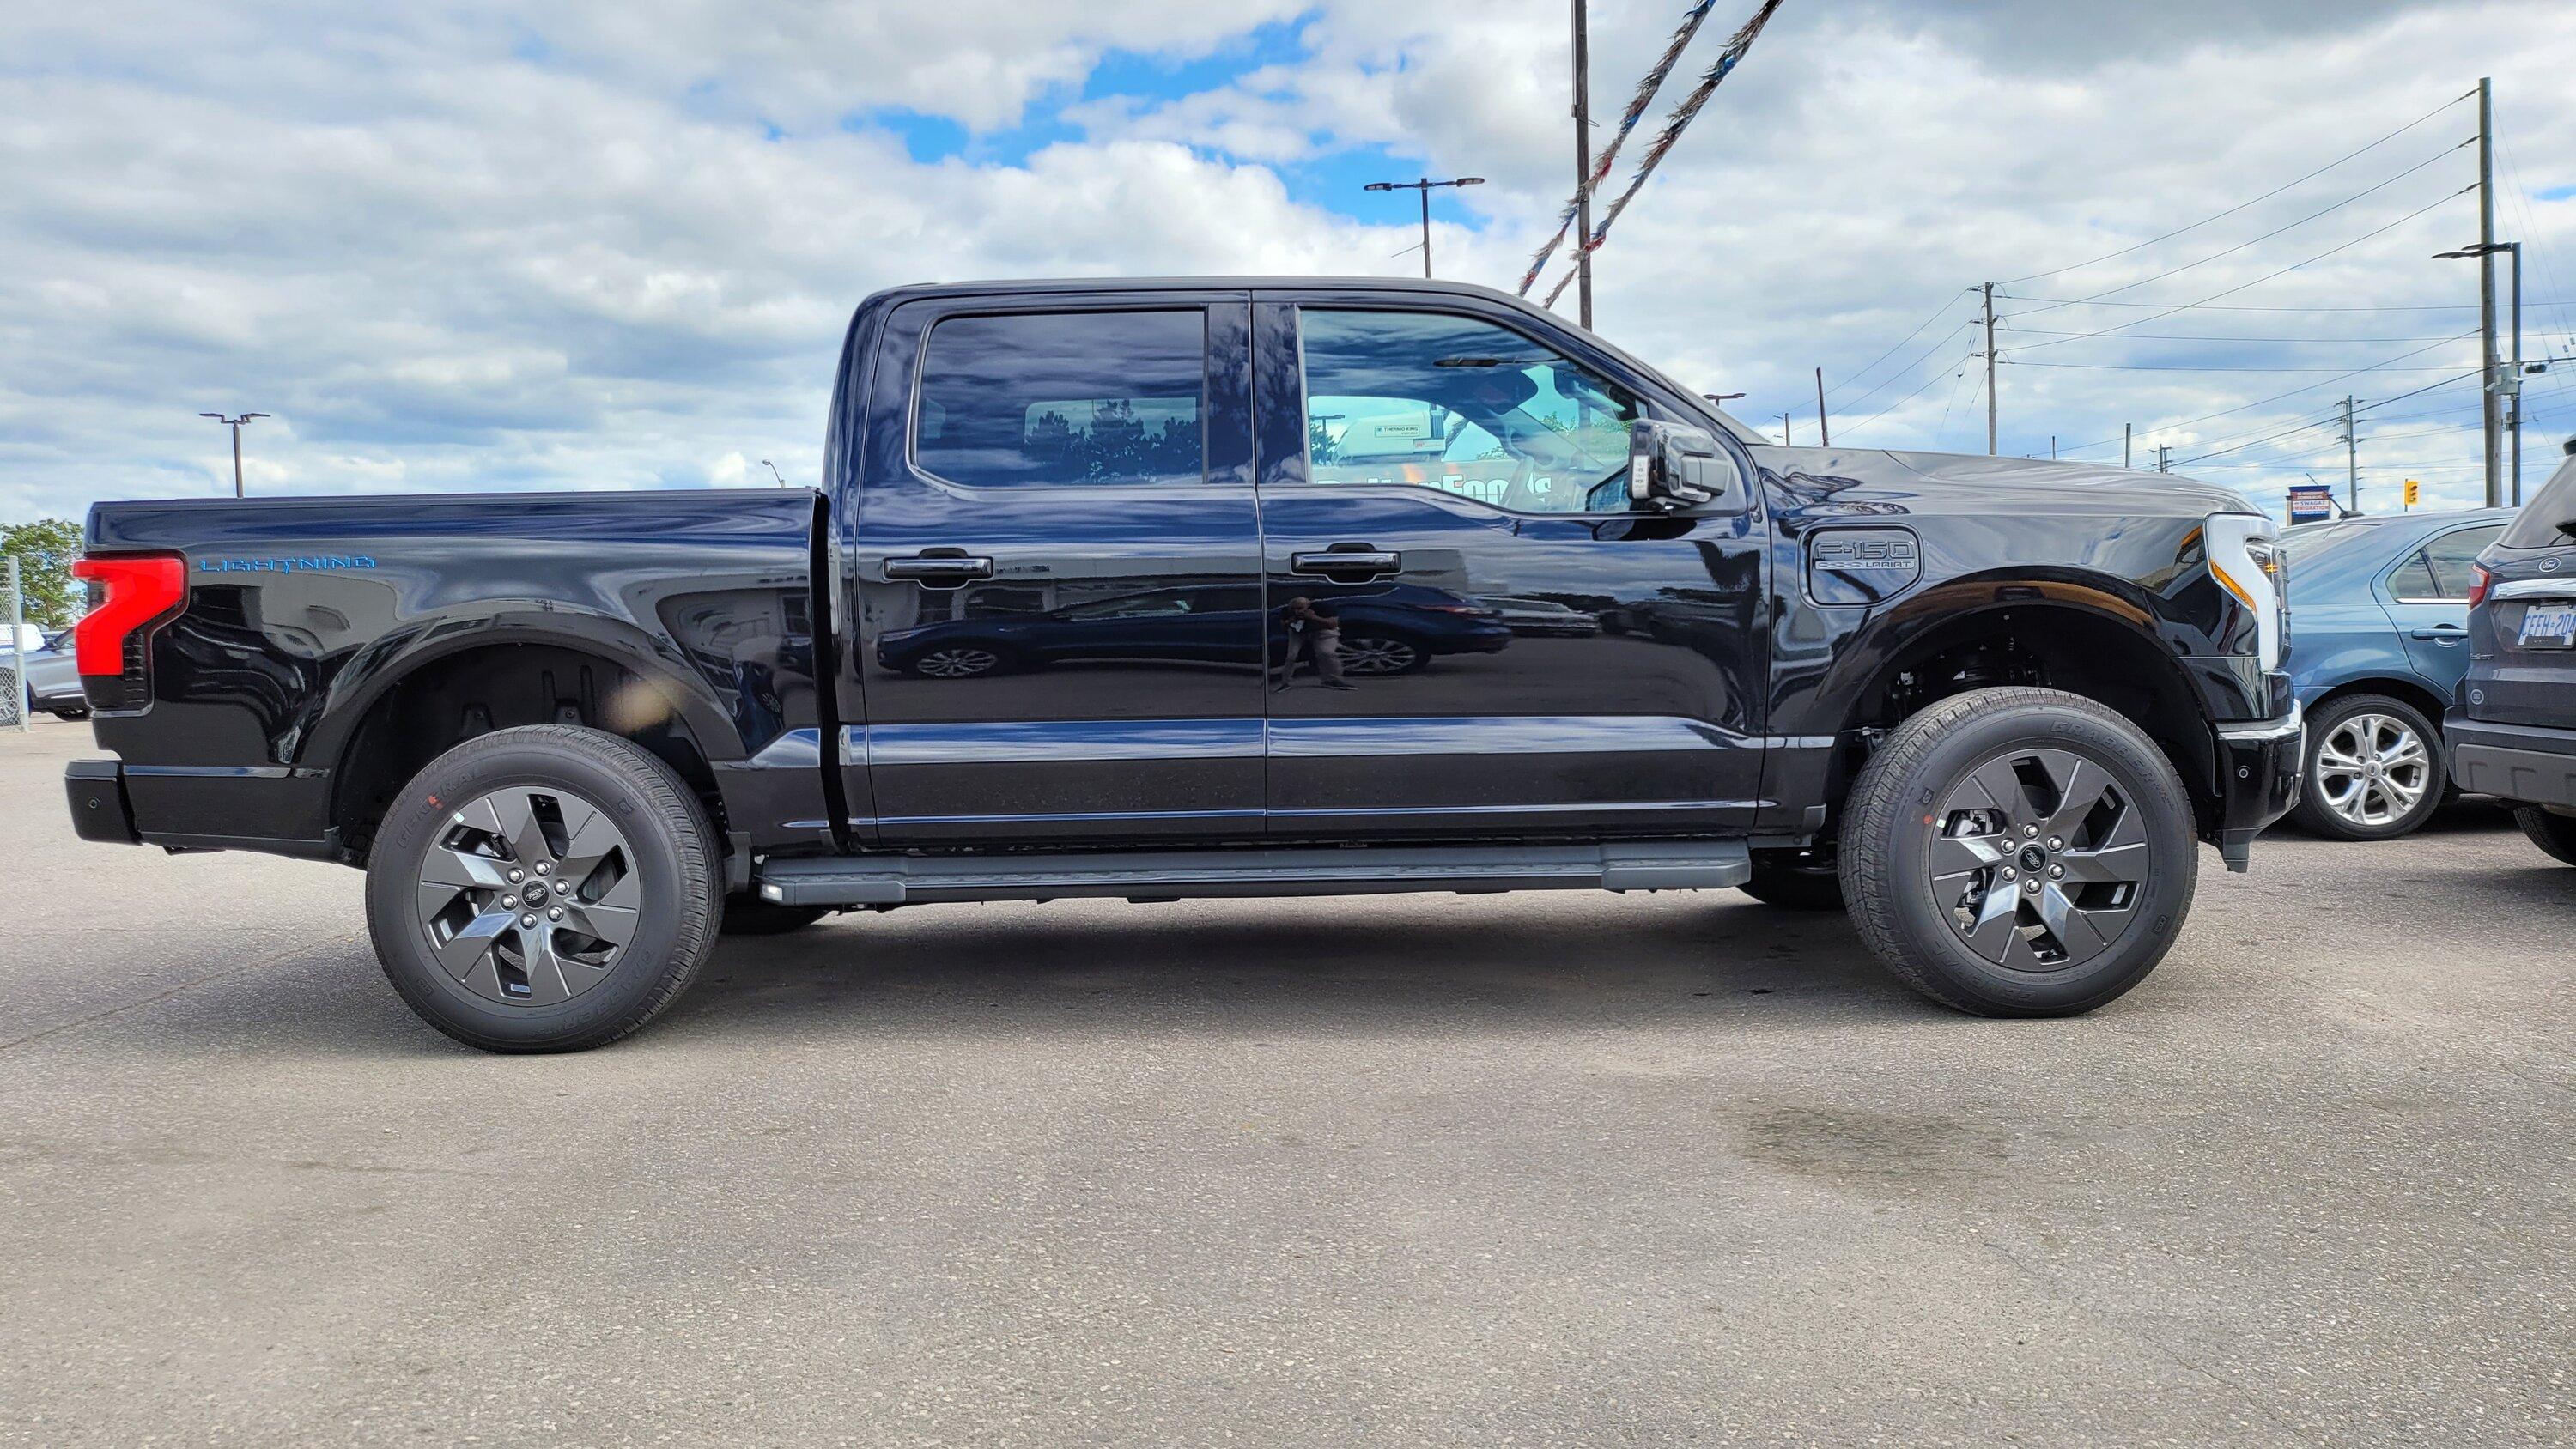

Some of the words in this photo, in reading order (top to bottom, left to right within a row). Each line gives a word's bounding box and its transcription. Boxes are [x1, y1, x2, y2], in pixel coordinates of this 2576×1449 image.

[1814, 541, 1916, 559] F-150
[200, 555, 376, 574] LIGHTNING
[396, 766, 488, 849] GENRAL
